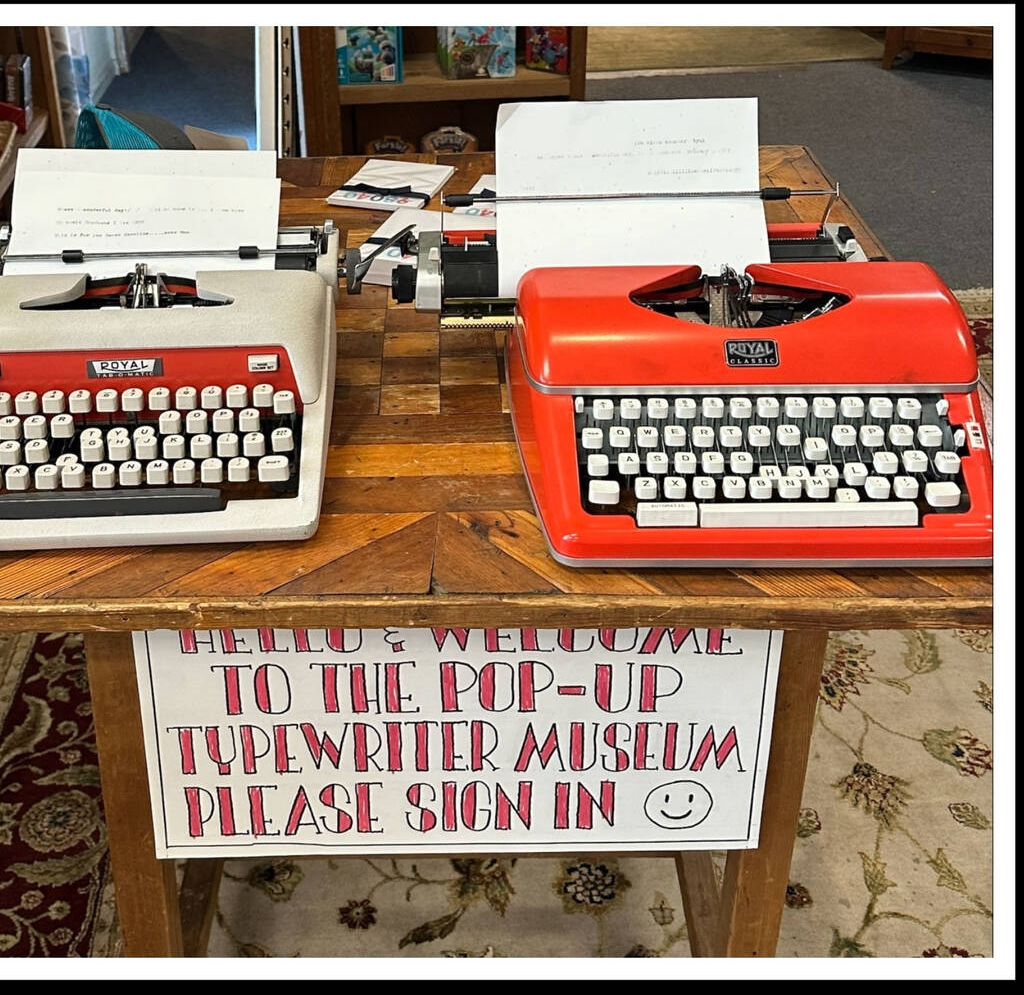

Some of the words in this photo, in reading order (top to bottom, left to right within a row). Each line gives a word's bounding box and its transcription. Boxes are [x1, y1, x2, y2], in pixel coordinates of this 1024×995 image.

[99, 360, 150, 373] ROYAL
[728, 342, 775, 356] ROYAL
[211, 663, 292, 715] TO
[309, 662, 420, 715] THE
[440, 661, 683, 715] POP-UP
[166, 721, 501, 776] TYPEWRITER
[514, 721, 747, 774] MUSEUM
[183, 781, 385, 838] PLEASE
[405, 781, 533, 834] SIGN
[553, 780, 618, 830] IN
